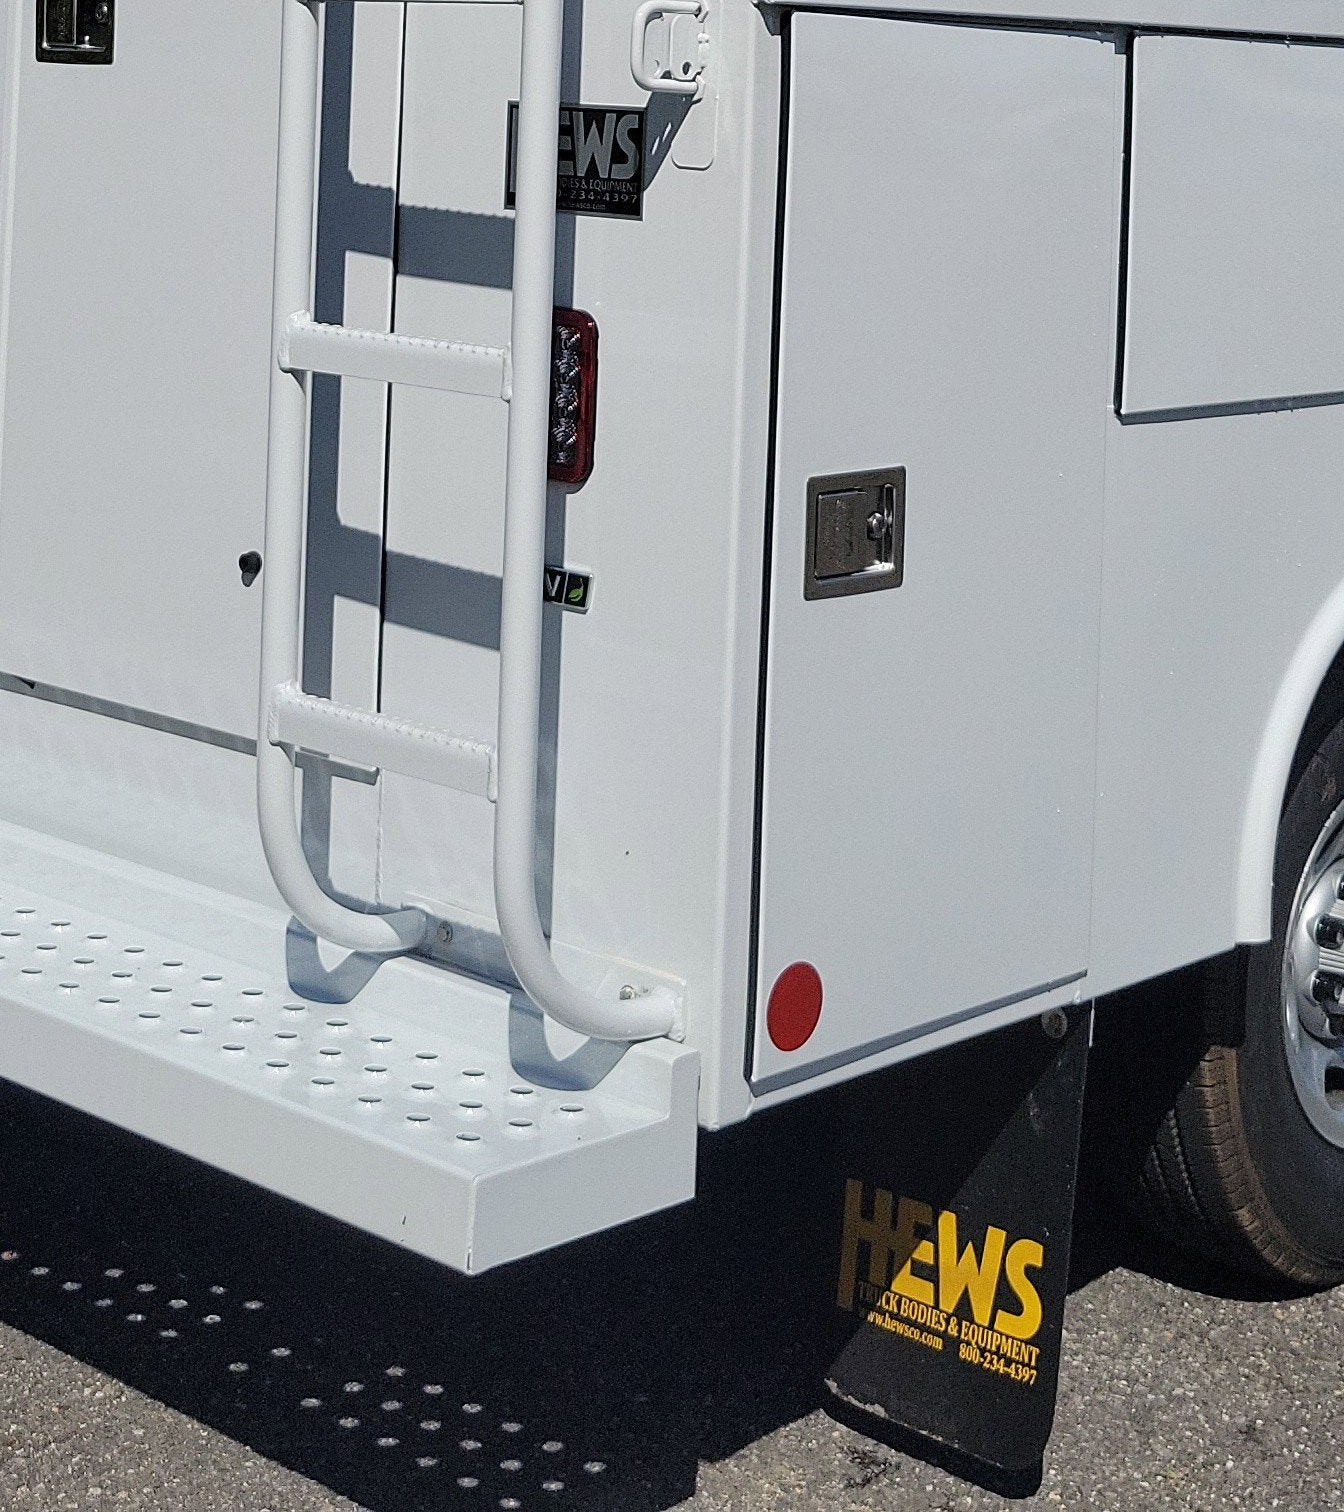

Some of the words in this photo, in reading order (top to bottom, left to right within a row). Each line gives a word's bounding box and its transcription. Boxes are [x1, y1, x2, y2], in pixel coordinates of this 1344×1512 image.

[510, 108, 639, 192] EWS
[837, 1177, 1044, 1341] HEWS
[862, 1308, 944, 1352] ww.hewsco.com
[959, 1342, 1038, 1386] 800-234-4397
[900, 1298, 947, 1332] BODIES
[948, 1316, 959, 1336] &
[961, 1320, 1040, 1367] EQUIPMENT
